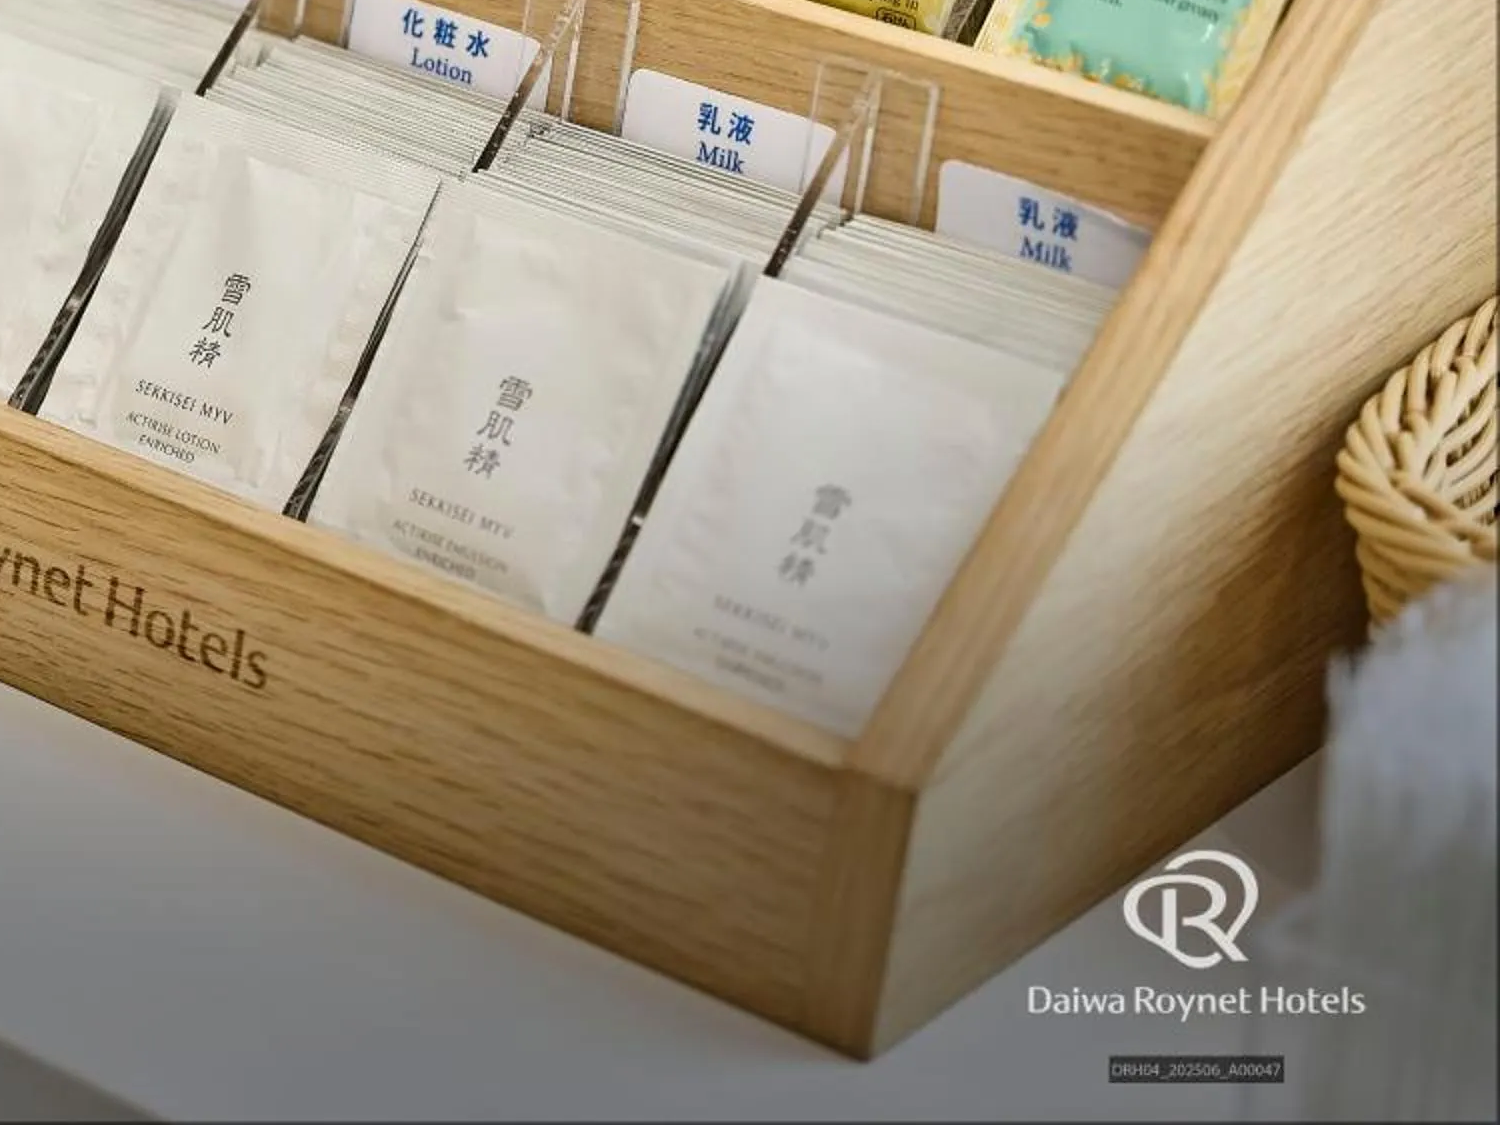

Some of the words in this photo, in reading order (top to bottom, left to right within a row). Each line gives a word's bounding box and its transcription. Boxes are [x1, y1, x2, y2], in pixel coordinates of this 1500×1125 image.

[401, 7, 491, 59] 化粧水
[410, 47, 474, 85] Lotion
[697, 101, 755, 147] 乳液
[695, 139, 745, 175] Milk
[1016, 195, 1081, 241] 乳液
[1019, 233, 1073, 272] Milk
[188, 273, 251, 370] 雪肌精
[135, 378, 197, 412] SEKKISEI
[199, 402, 233, 425] MYV
[462, 374, 534, 480] 雪肌精
[103, 576, 270, 692] Hotels
